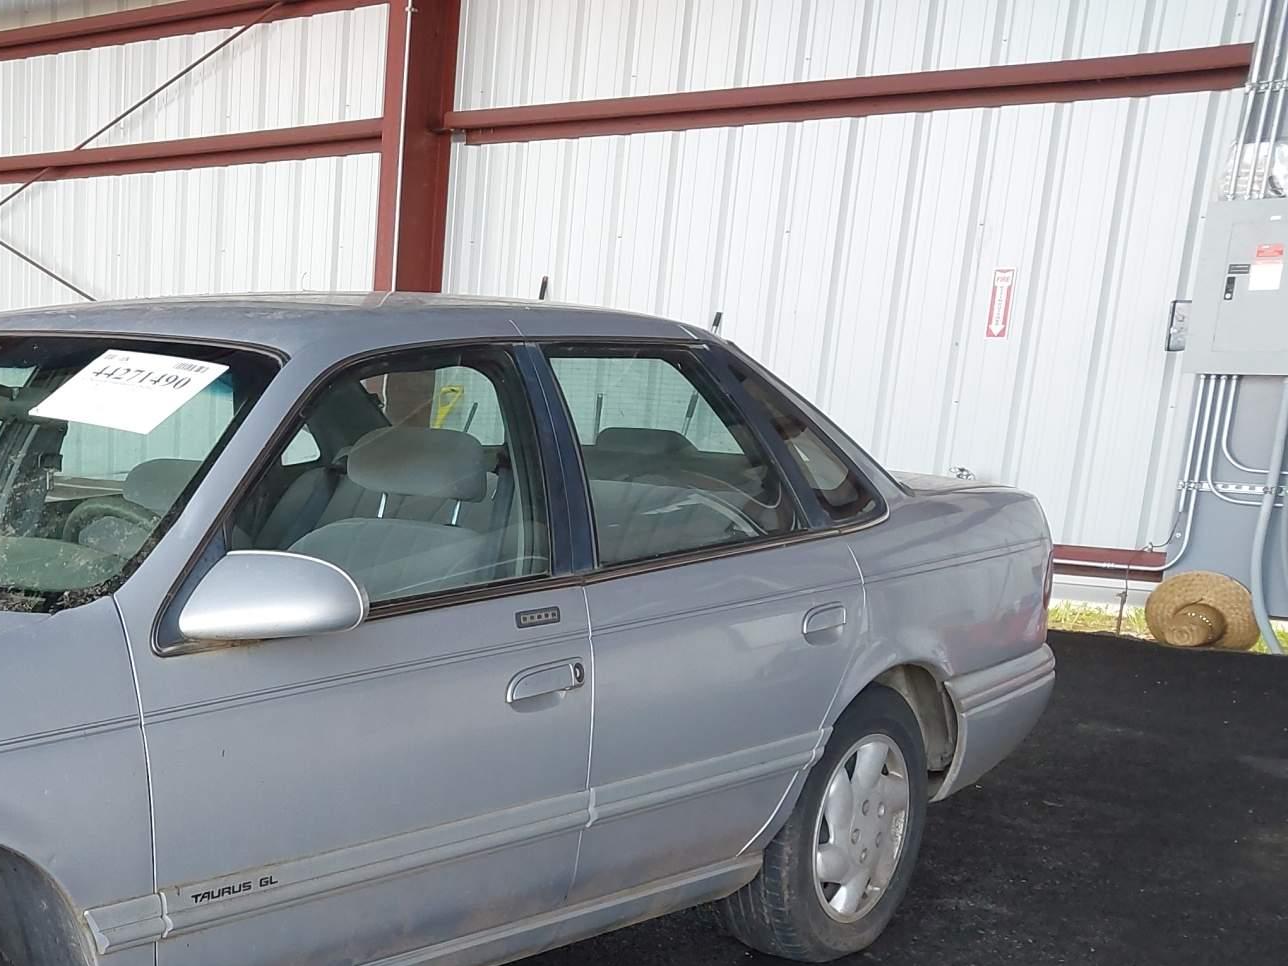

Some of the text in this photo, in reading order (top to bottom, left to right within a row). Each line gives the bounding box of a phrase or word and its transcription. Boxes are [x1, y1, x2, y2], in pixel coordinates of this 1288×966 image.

[92, 364, 192, 390] 44271490
[191, 875, 279, 904] TAURUS GL
